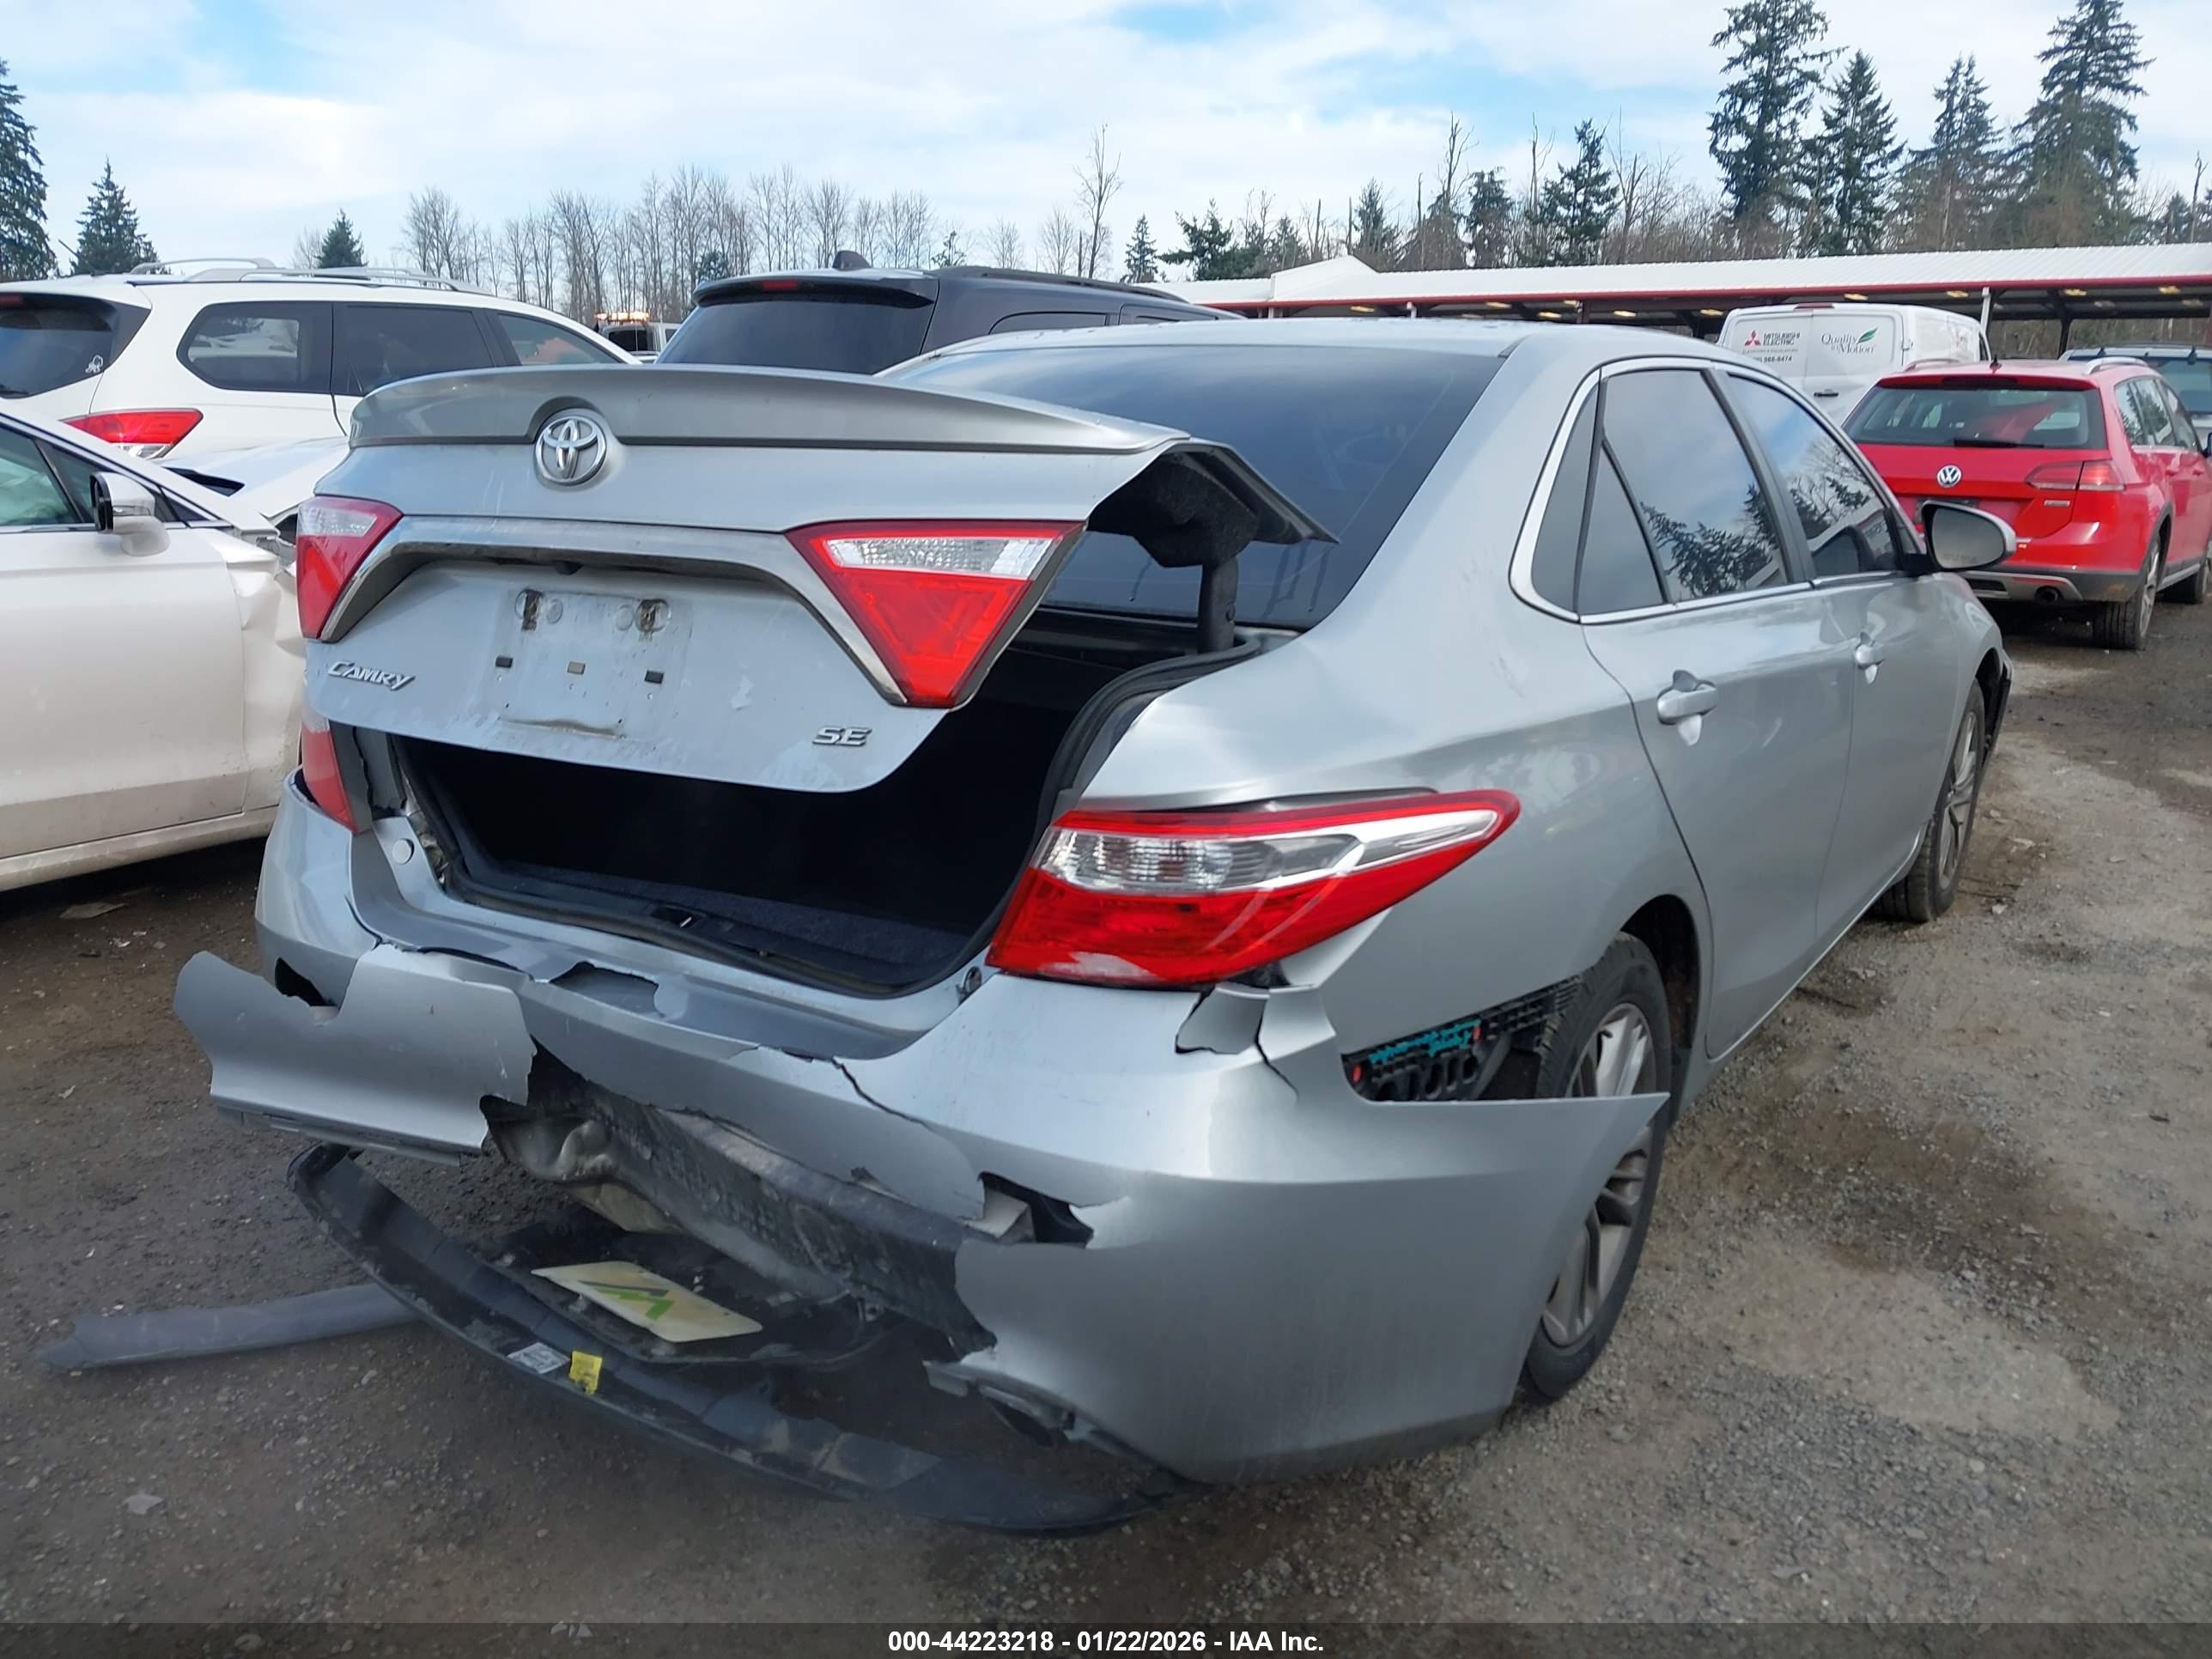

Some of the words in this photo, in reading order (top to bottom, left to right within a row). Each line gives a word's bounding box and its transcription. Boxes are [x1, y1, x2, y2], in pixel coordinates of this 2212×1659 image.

[1763, 337, 1795, 346] ELECTRIC
[1821, 332, 1858, 345] Quality
[1838, 342, 1875, 354] Motion
[327, 659, 416, 692] CAMRY
[811, 726, 873, 748] SE
